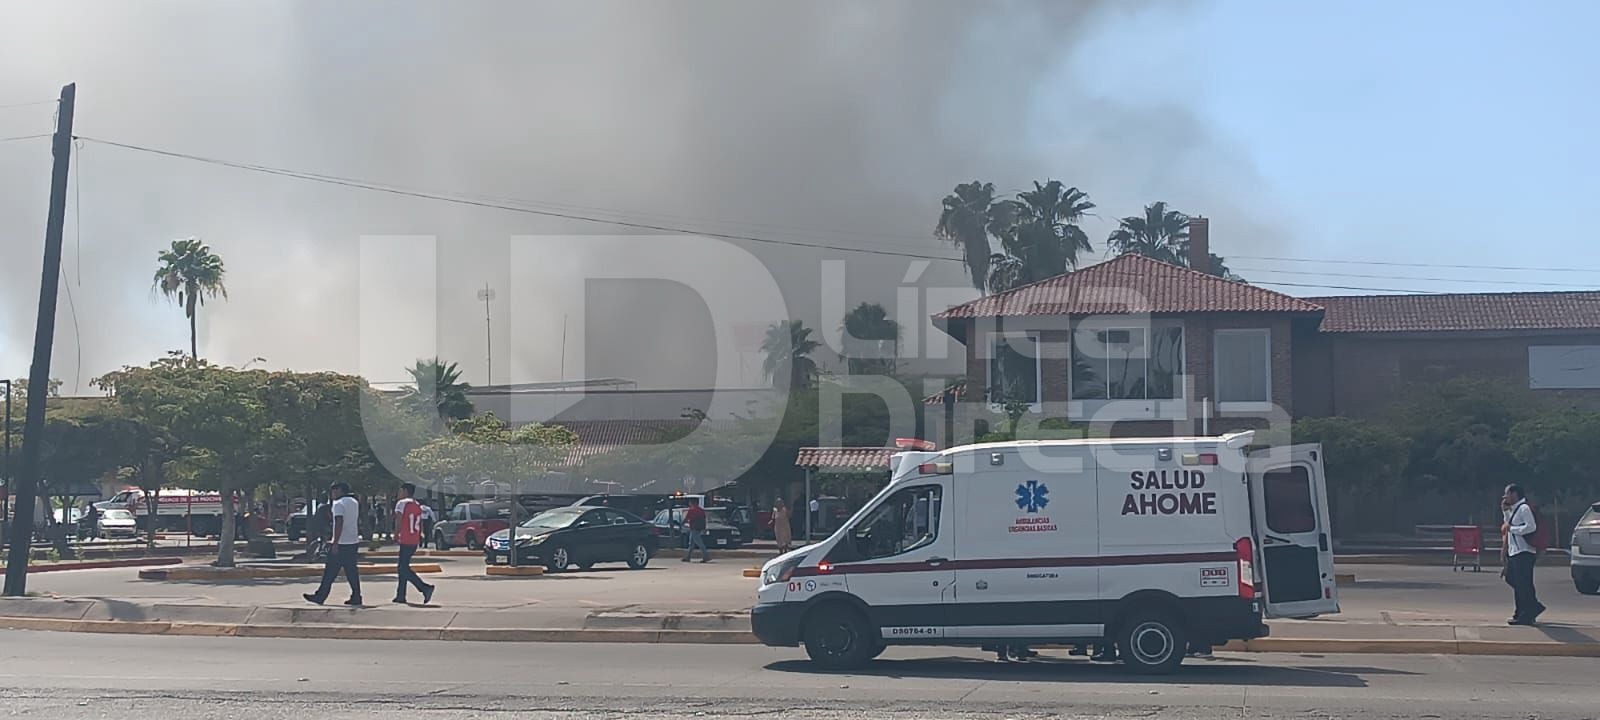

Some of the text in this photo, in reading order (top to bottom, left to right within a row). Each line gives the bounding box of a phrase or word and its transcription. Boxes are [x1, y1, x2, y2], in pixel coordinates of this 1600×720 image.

[1131, 470, 1205, 490] SALUD
[1121, 492, 1217, 515] AHOME
[409, 513, 421, 534] 14
[789, 582, 802, 592] 01
